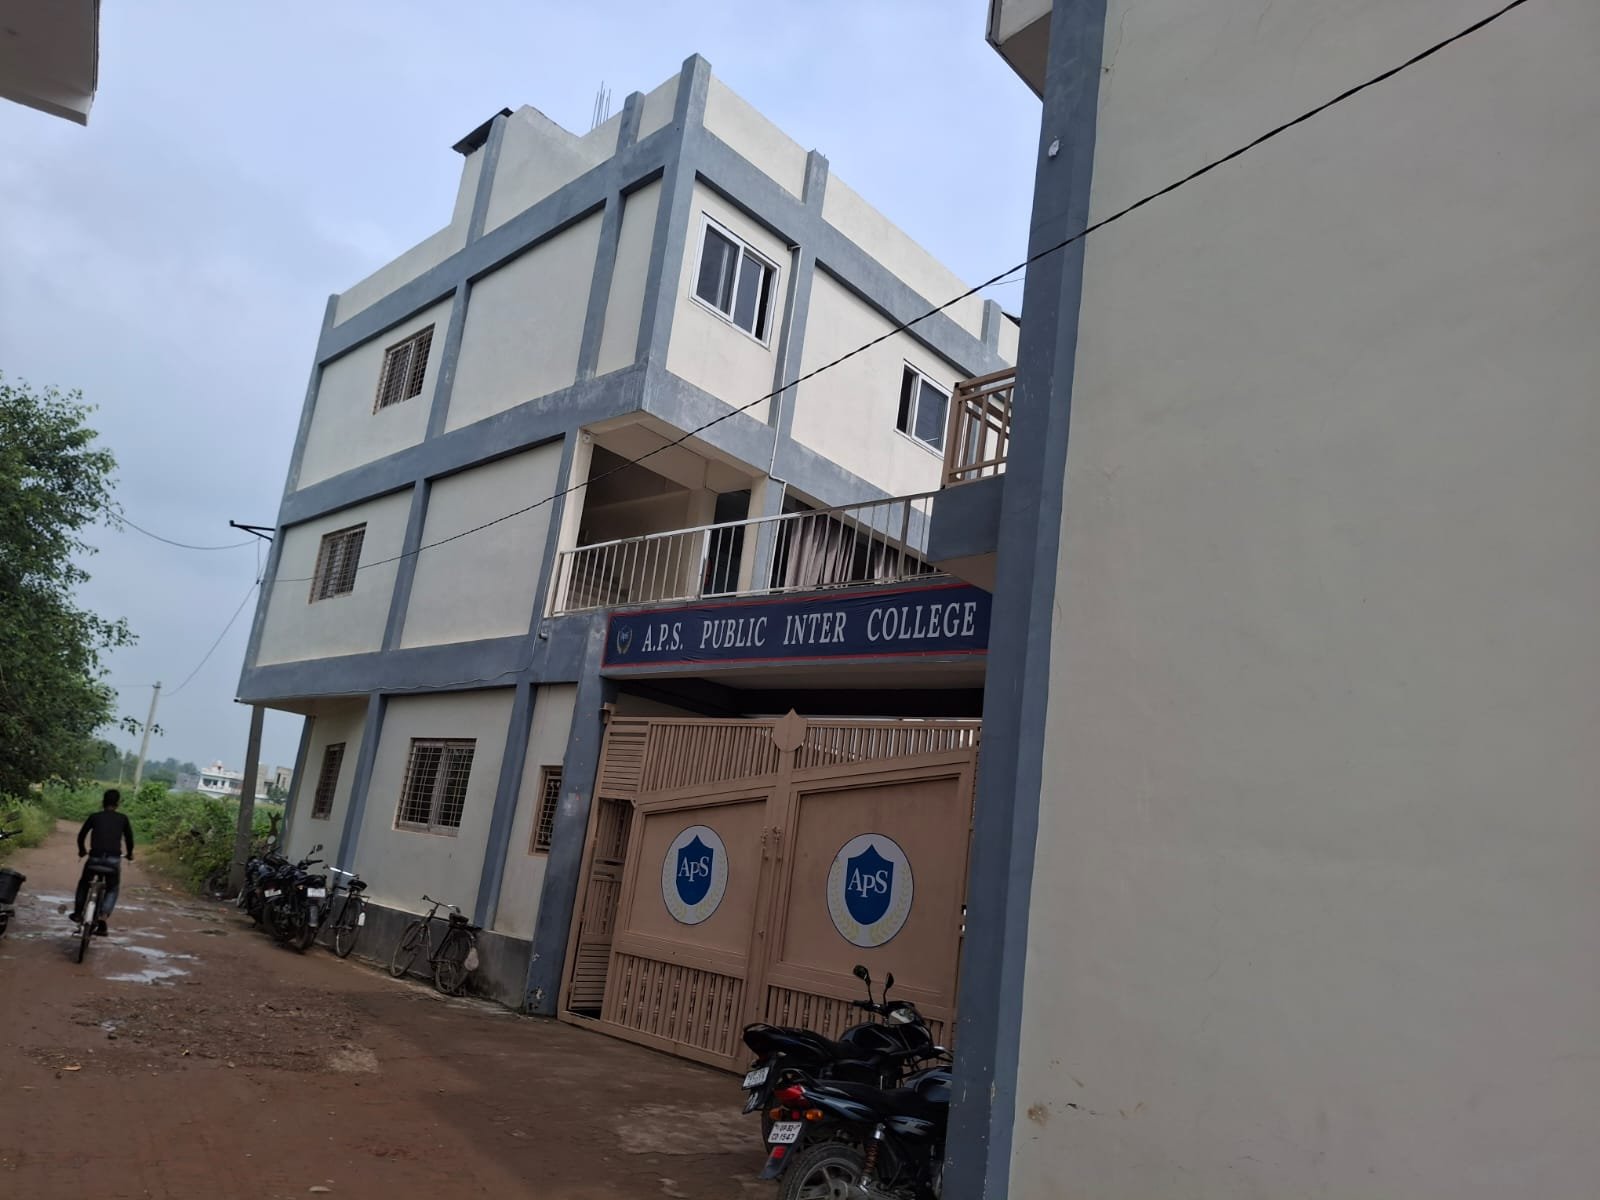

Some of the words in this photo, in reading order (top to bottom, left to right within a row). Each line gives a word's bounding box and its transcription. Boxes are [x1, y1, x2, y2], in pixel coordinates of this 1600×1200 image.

[641, 622, 684, 652] A.P.S.
[699, 616, 768, 649] PUBLIC
[783, 612, 848, 646] INTER
[866, 601, 978, 642] COLLEGE
